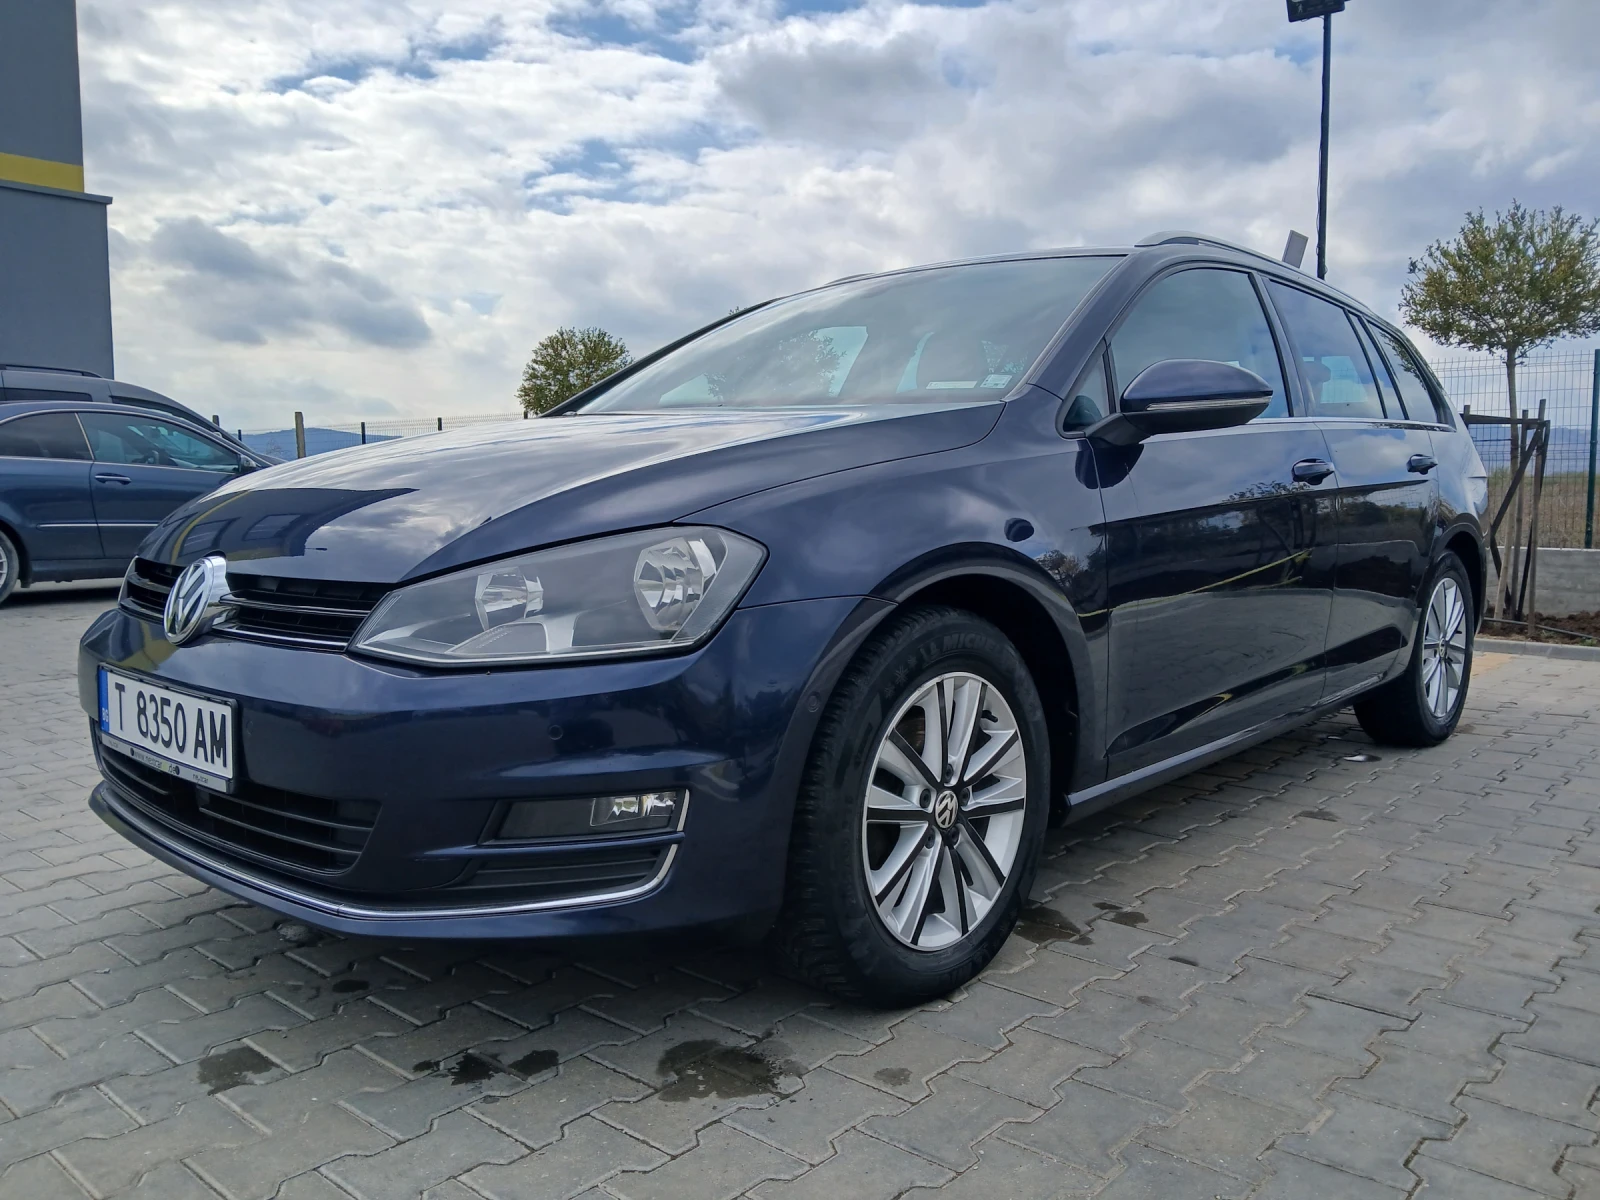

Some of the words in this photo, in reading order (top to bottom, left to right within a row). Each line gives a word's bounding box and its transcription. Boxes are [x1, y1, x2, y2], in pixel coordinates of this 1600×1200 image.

[114, 682, 126, 731] T
[136, 690, 187, 754] 8350
[193, 707, 228, 768] AM
